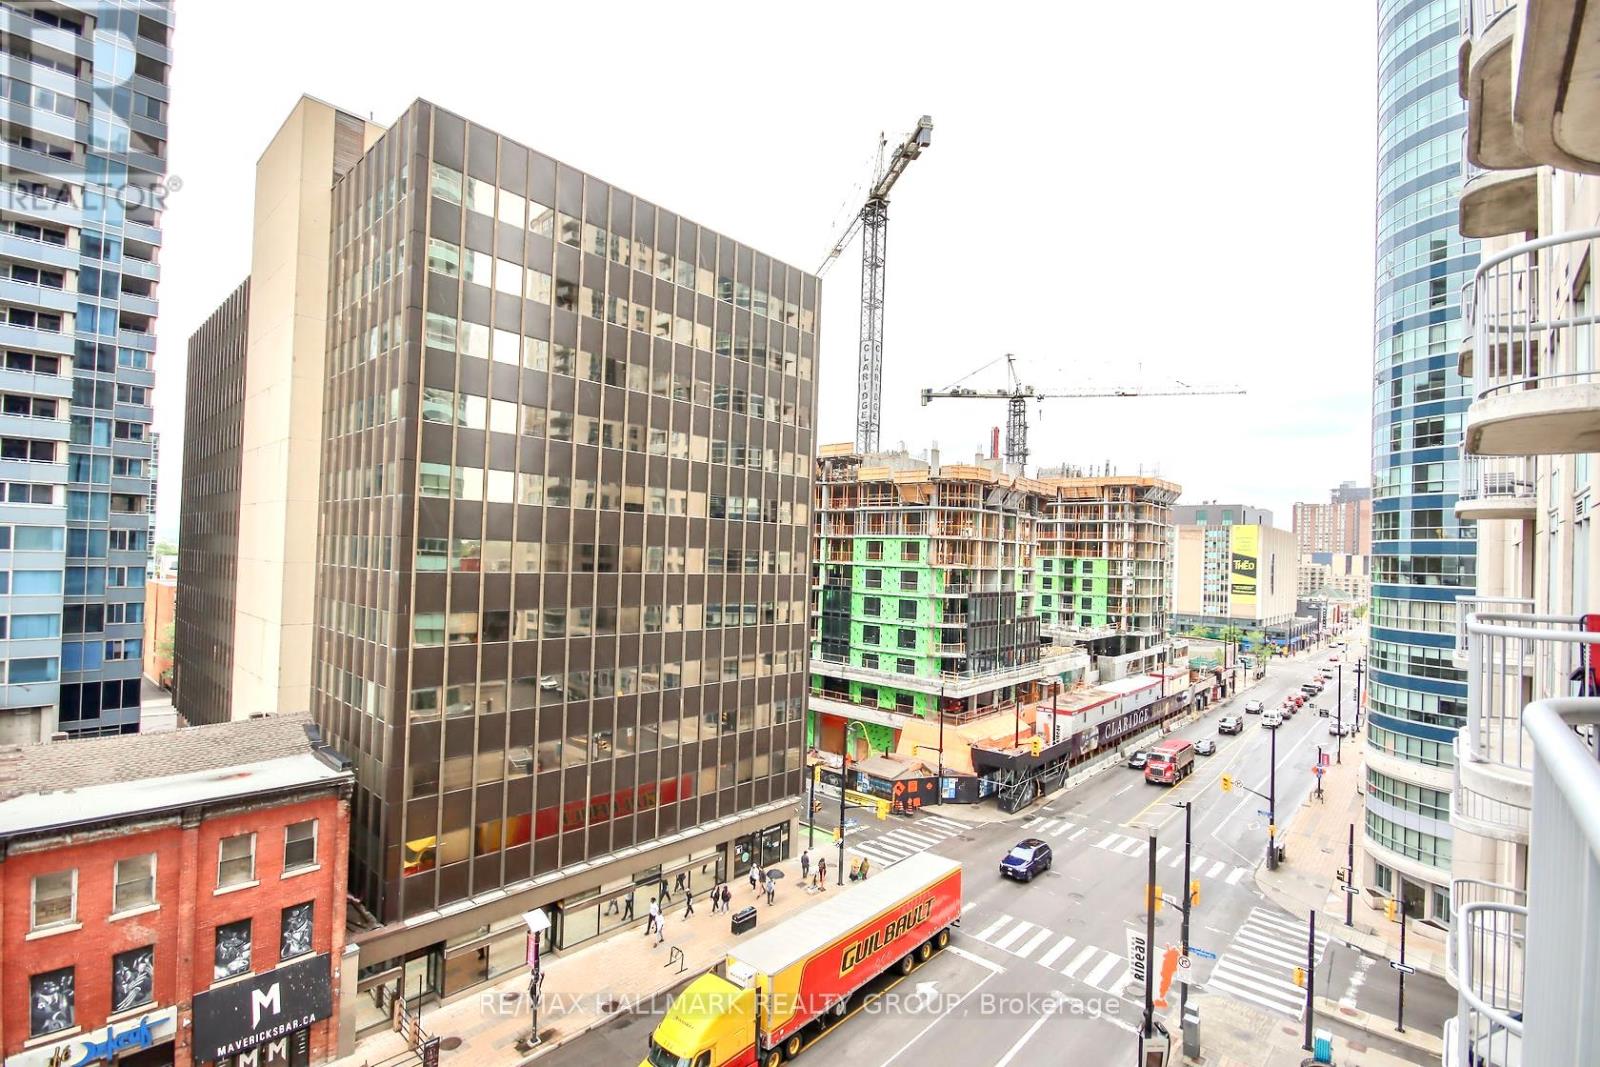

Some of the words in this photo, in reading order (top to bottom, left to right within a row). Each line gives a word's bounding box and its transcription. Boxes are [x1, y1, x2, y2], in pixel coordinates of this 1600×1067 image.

[861, 343, 870, 420] CLARIDGE
[1104, 708, 1149, 739] CLARIDGE
[840, 897, 935, 975] GUILBAULT
[251, 982, 281, 1030] M
[217, 1013, 316, 1057] MAVERICKSBAR.CA
[268, 1037, 287, 1062] M
